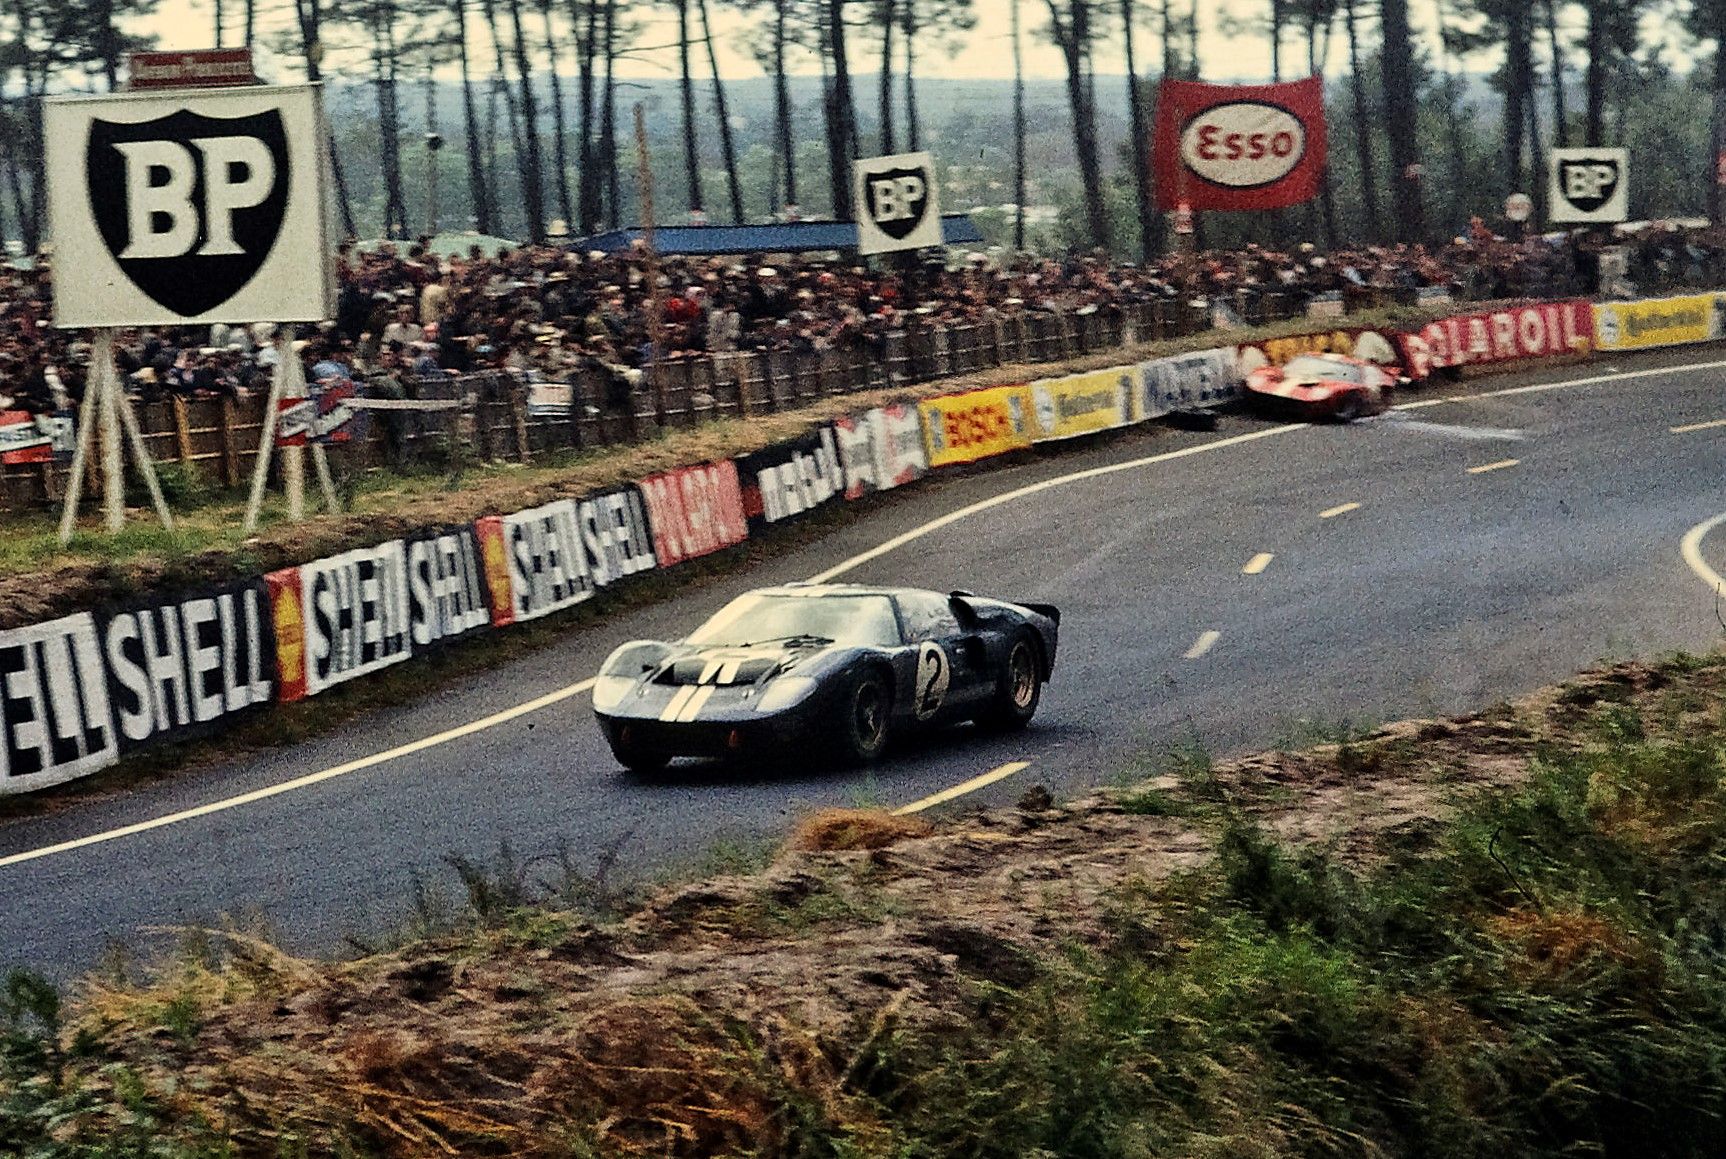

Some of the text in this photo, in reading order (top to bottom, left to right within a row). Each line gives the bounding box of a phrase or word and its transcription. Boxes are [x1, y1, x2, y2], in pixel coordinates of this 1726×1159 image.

[111, 135, 275, 259] BP
[870, 176, 924, 222] BP
[1564, 165, 1616, 199] BP
[313, 557, 412, 680] SHELL
[411, 532, 490, 645] SHELL
[106, 589, 272, 740] SHELL
[919, 649, 942, 713] 2
